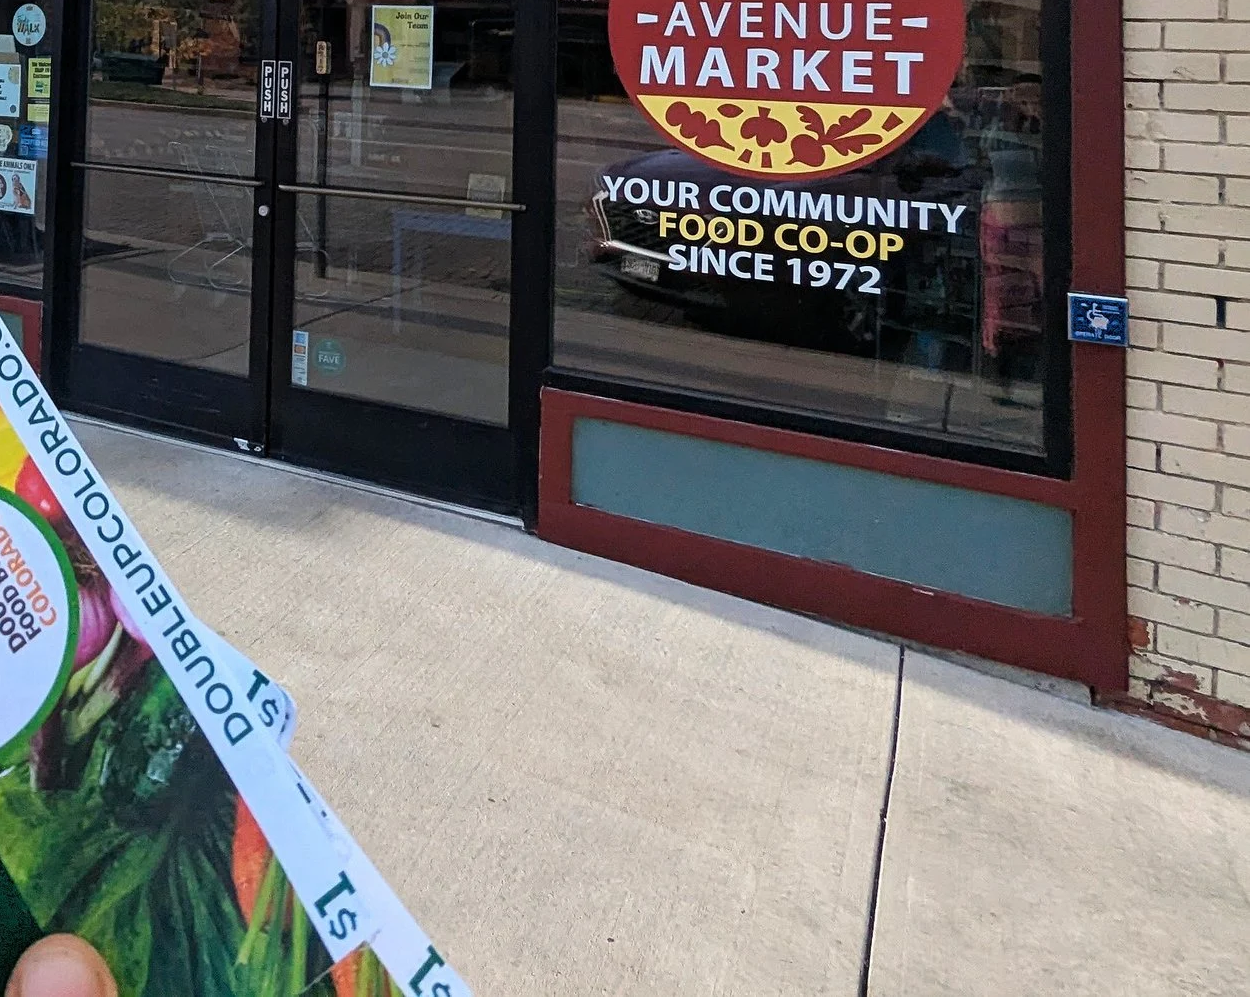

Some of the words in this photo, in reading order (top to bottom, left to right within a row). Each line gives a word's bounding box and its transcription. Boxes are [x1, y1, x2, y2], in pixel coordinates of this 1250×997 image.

[395, 12, 412, 20] Join
[414, 12, 429, 20] Our
[407, 21, 429, 30] Team
[263, 66, 273, 112] PUSH
[280, 66, 290, 114] PUSH
[639, 45, 924, 95] MARKET
[3, 161, 23, 171] ANIMALS
[23, 163, 36, 172] ONLY
[602, 175, 700, 209] YOUR
[708, 185, 968, 234] COMMUNITY
[658, 211, 764, 246] FOOD
[774, 223, 904, 262] CO-OP
[667, 244, 774, 282] SINCE
[786, 257, 882, 295] 1972
[318, 355, 340, 364] FAVE
[2, 584, 42, 641] FOOD
[313, 870, 358, 941] $1
